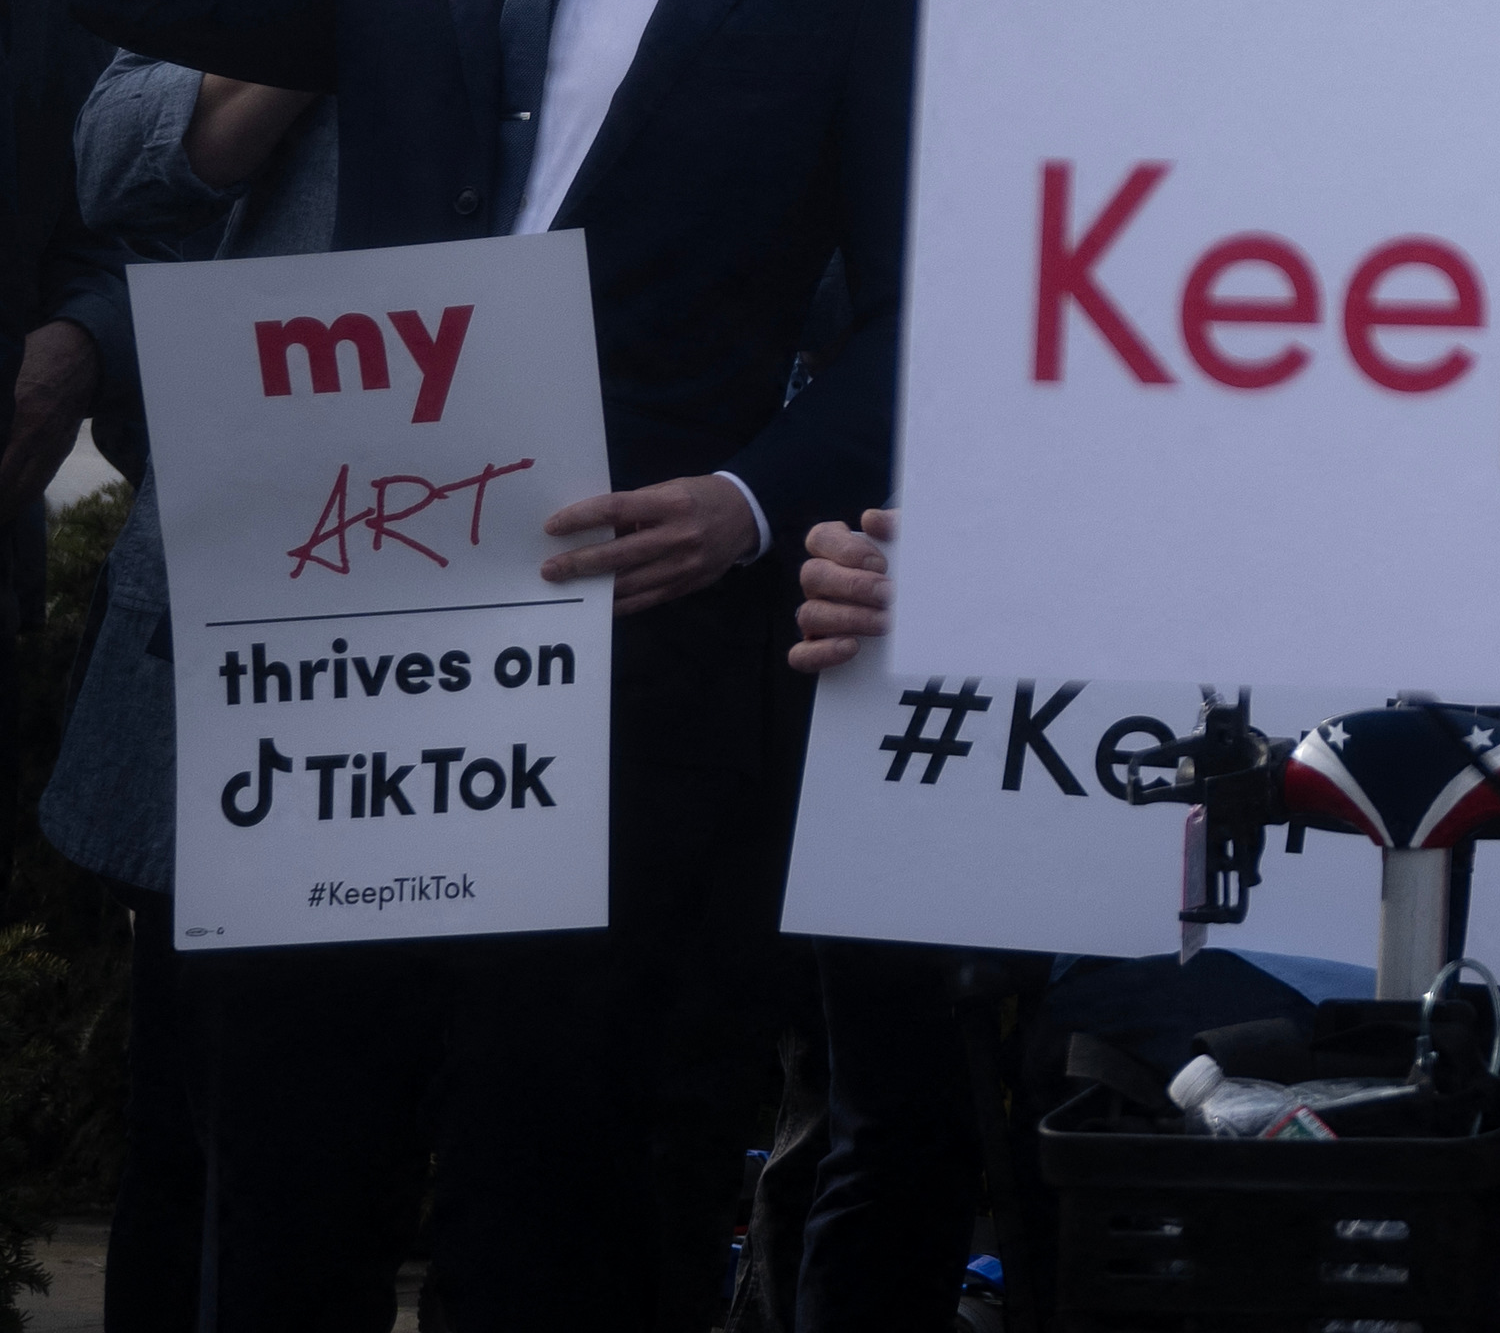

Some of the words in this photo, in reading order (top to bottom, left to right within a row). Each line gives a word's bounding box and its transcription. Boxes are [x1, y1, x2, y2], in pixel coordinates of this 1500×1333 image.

[254, 304, 475, 423] my
[289, 459, 533, 578] ART
[219, 638, 470, 705] thrives
[494, 644, 574, 688] on
[306, 744, 555, 820] TikTok
[308, 874, 474, 910] #KeepTikTok
